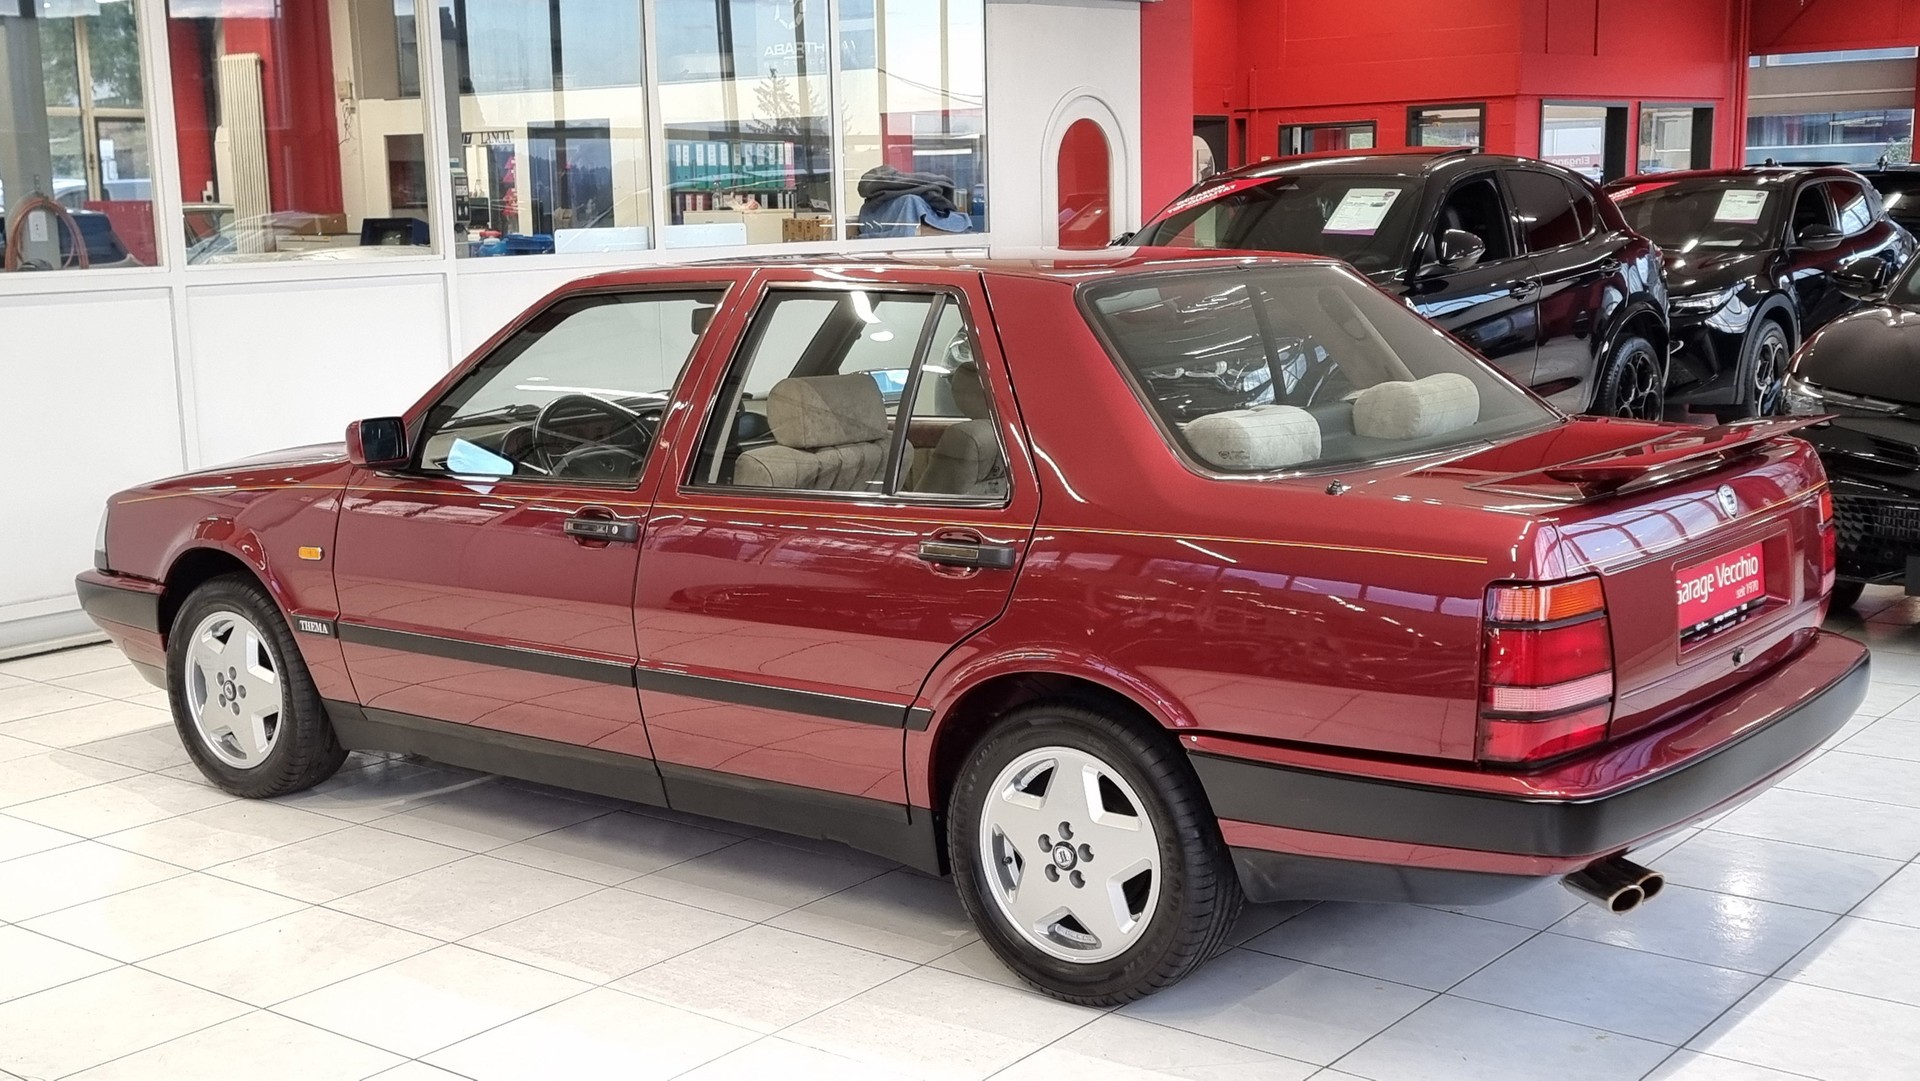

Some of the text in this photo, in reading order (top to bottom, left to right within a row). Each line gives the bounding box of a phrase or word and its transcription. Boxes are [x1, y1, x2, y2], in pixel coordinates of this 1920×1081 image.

[764, 41, 825, 56] ABARTH
[480, 131, 512, 144] LANCIA
[1715, 552, 1759, 588] Vecchio
[299, 620, 329, 634] THEMA
